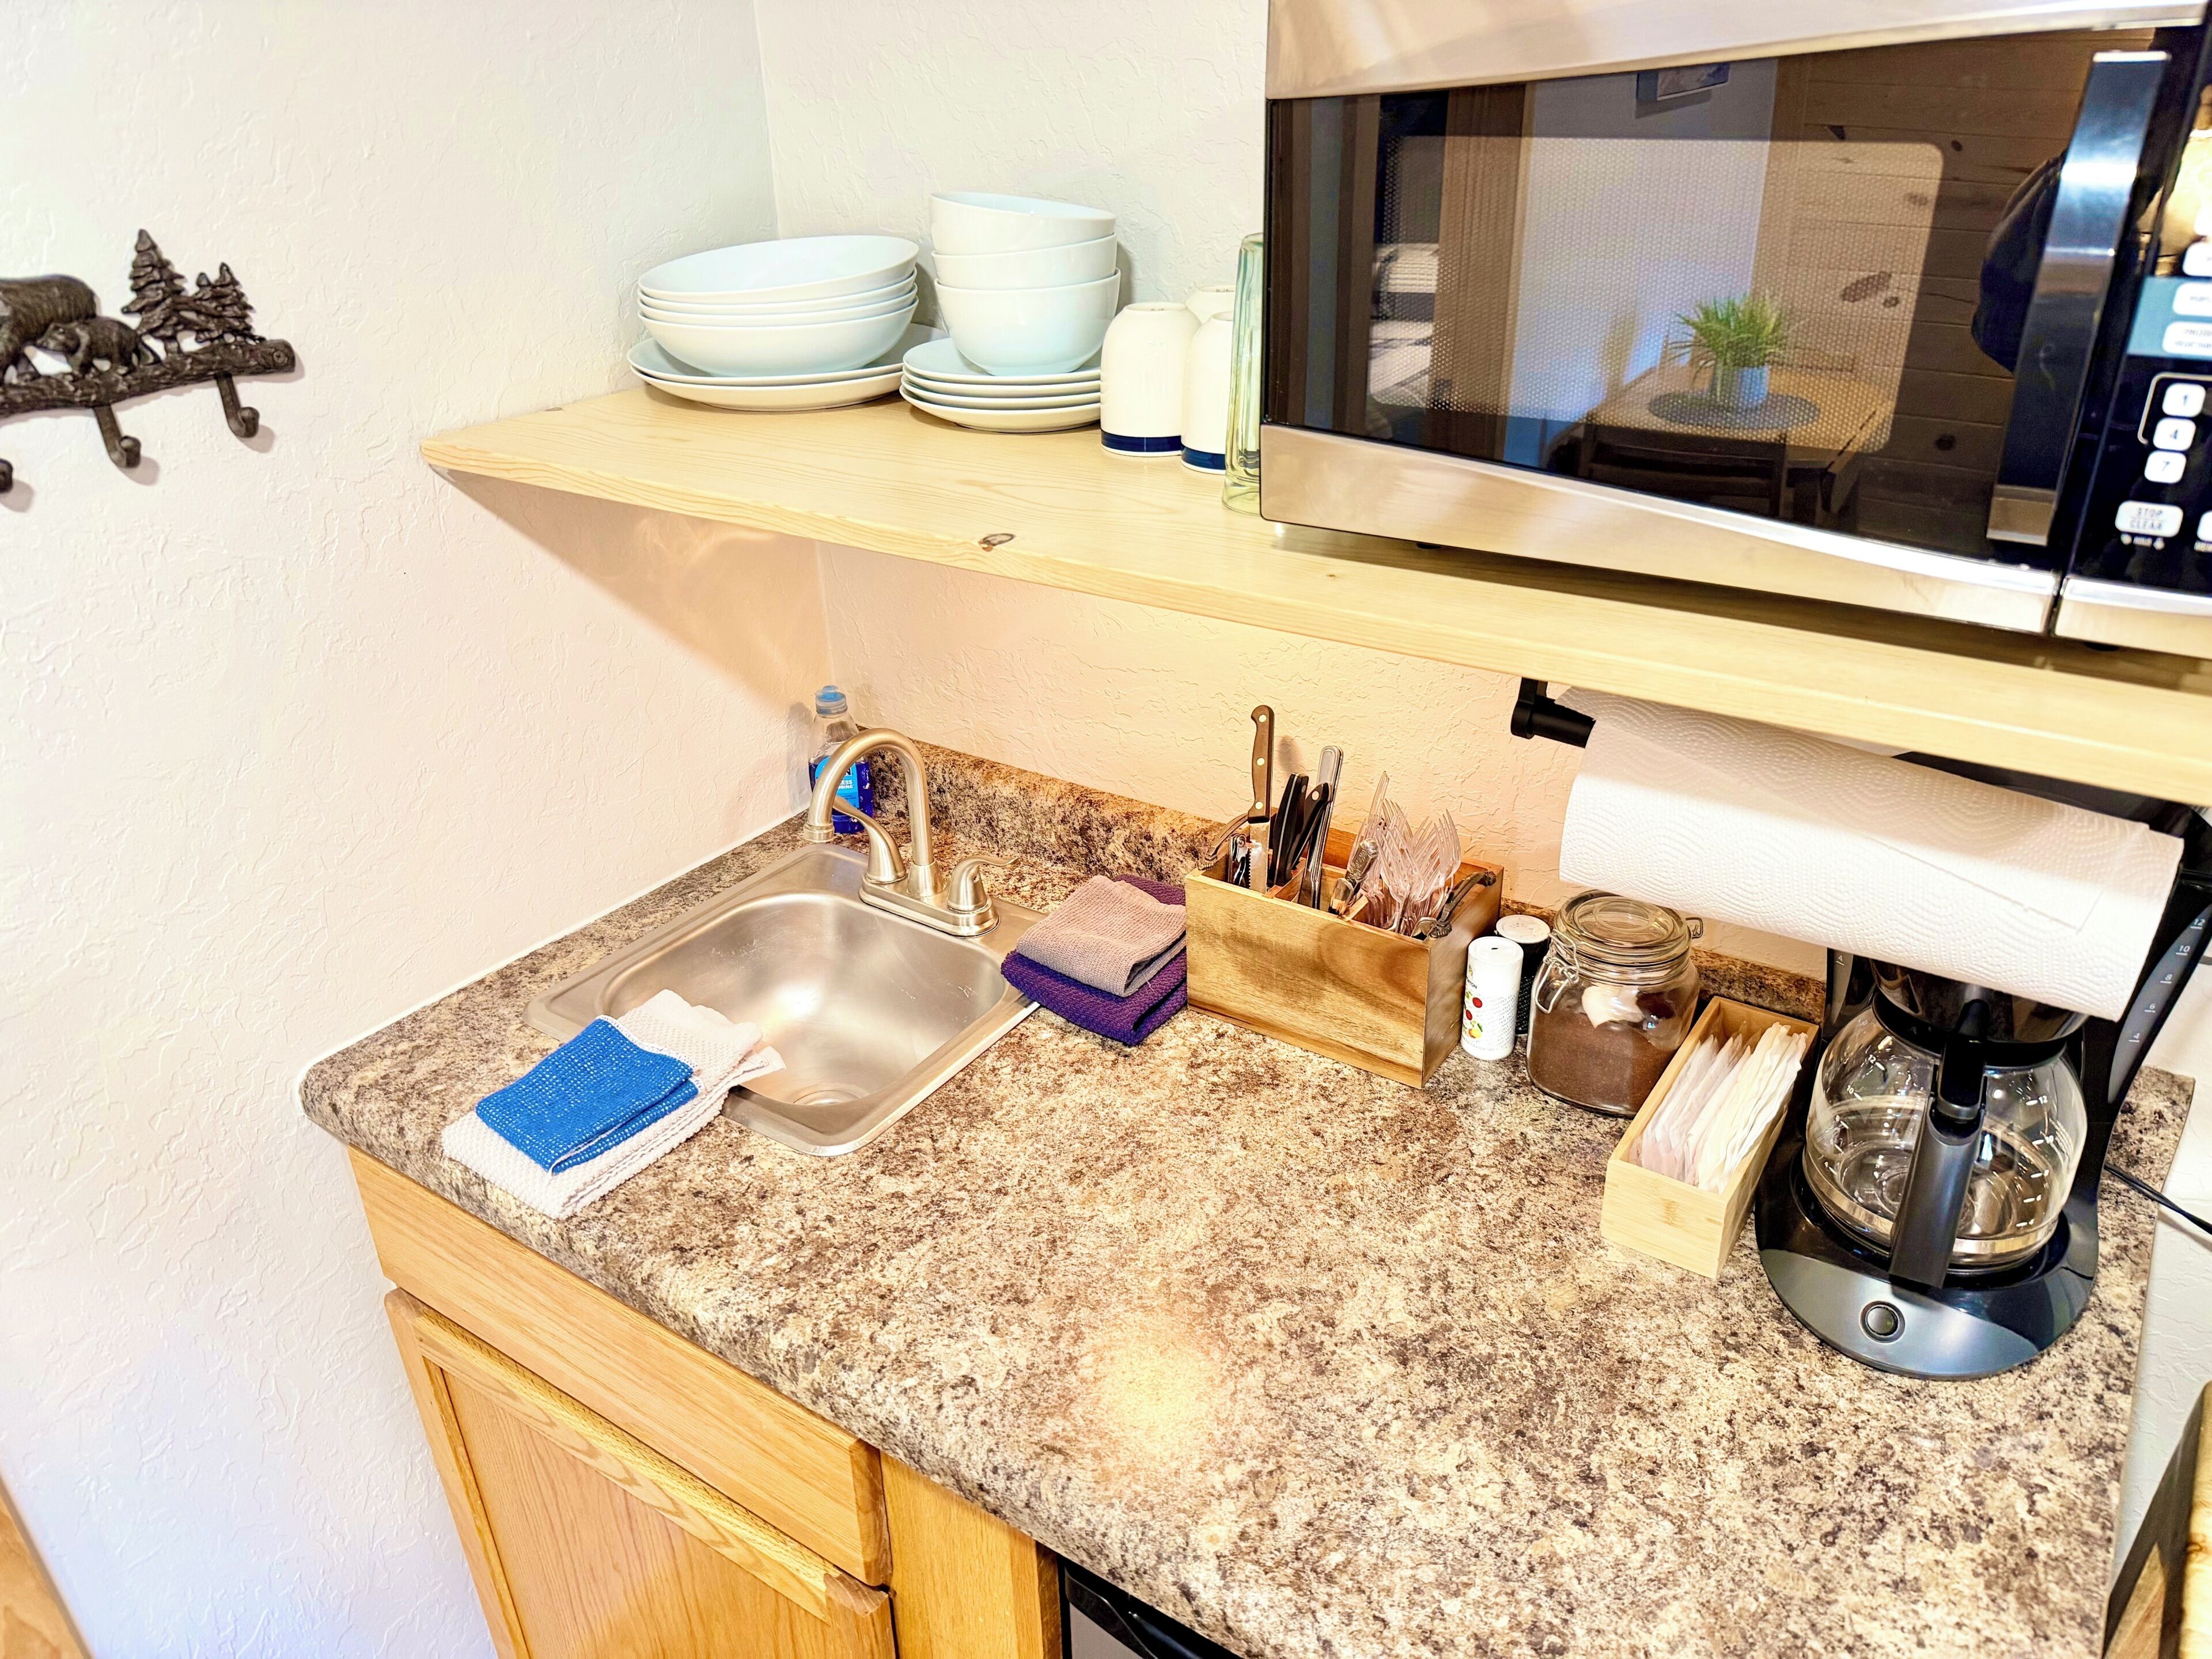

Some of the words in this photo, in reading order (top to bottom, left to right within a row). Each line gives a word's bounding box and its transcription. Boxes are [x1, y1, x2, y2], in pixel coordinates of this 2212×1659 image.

[2183, 395, 2188, 405] 1
[2169, 429, 2178, 440] 4
[2162, 461, 2170, 471] 7
[2136, 507, 2163, 517] STOP
[2130, 518, 2162, 530] CLEAR
[1868, 1054, 1877, 1063] 12
[1847, 1085, 1854, 1094] 10
[2038, 1095, 2048, 1104] 12
